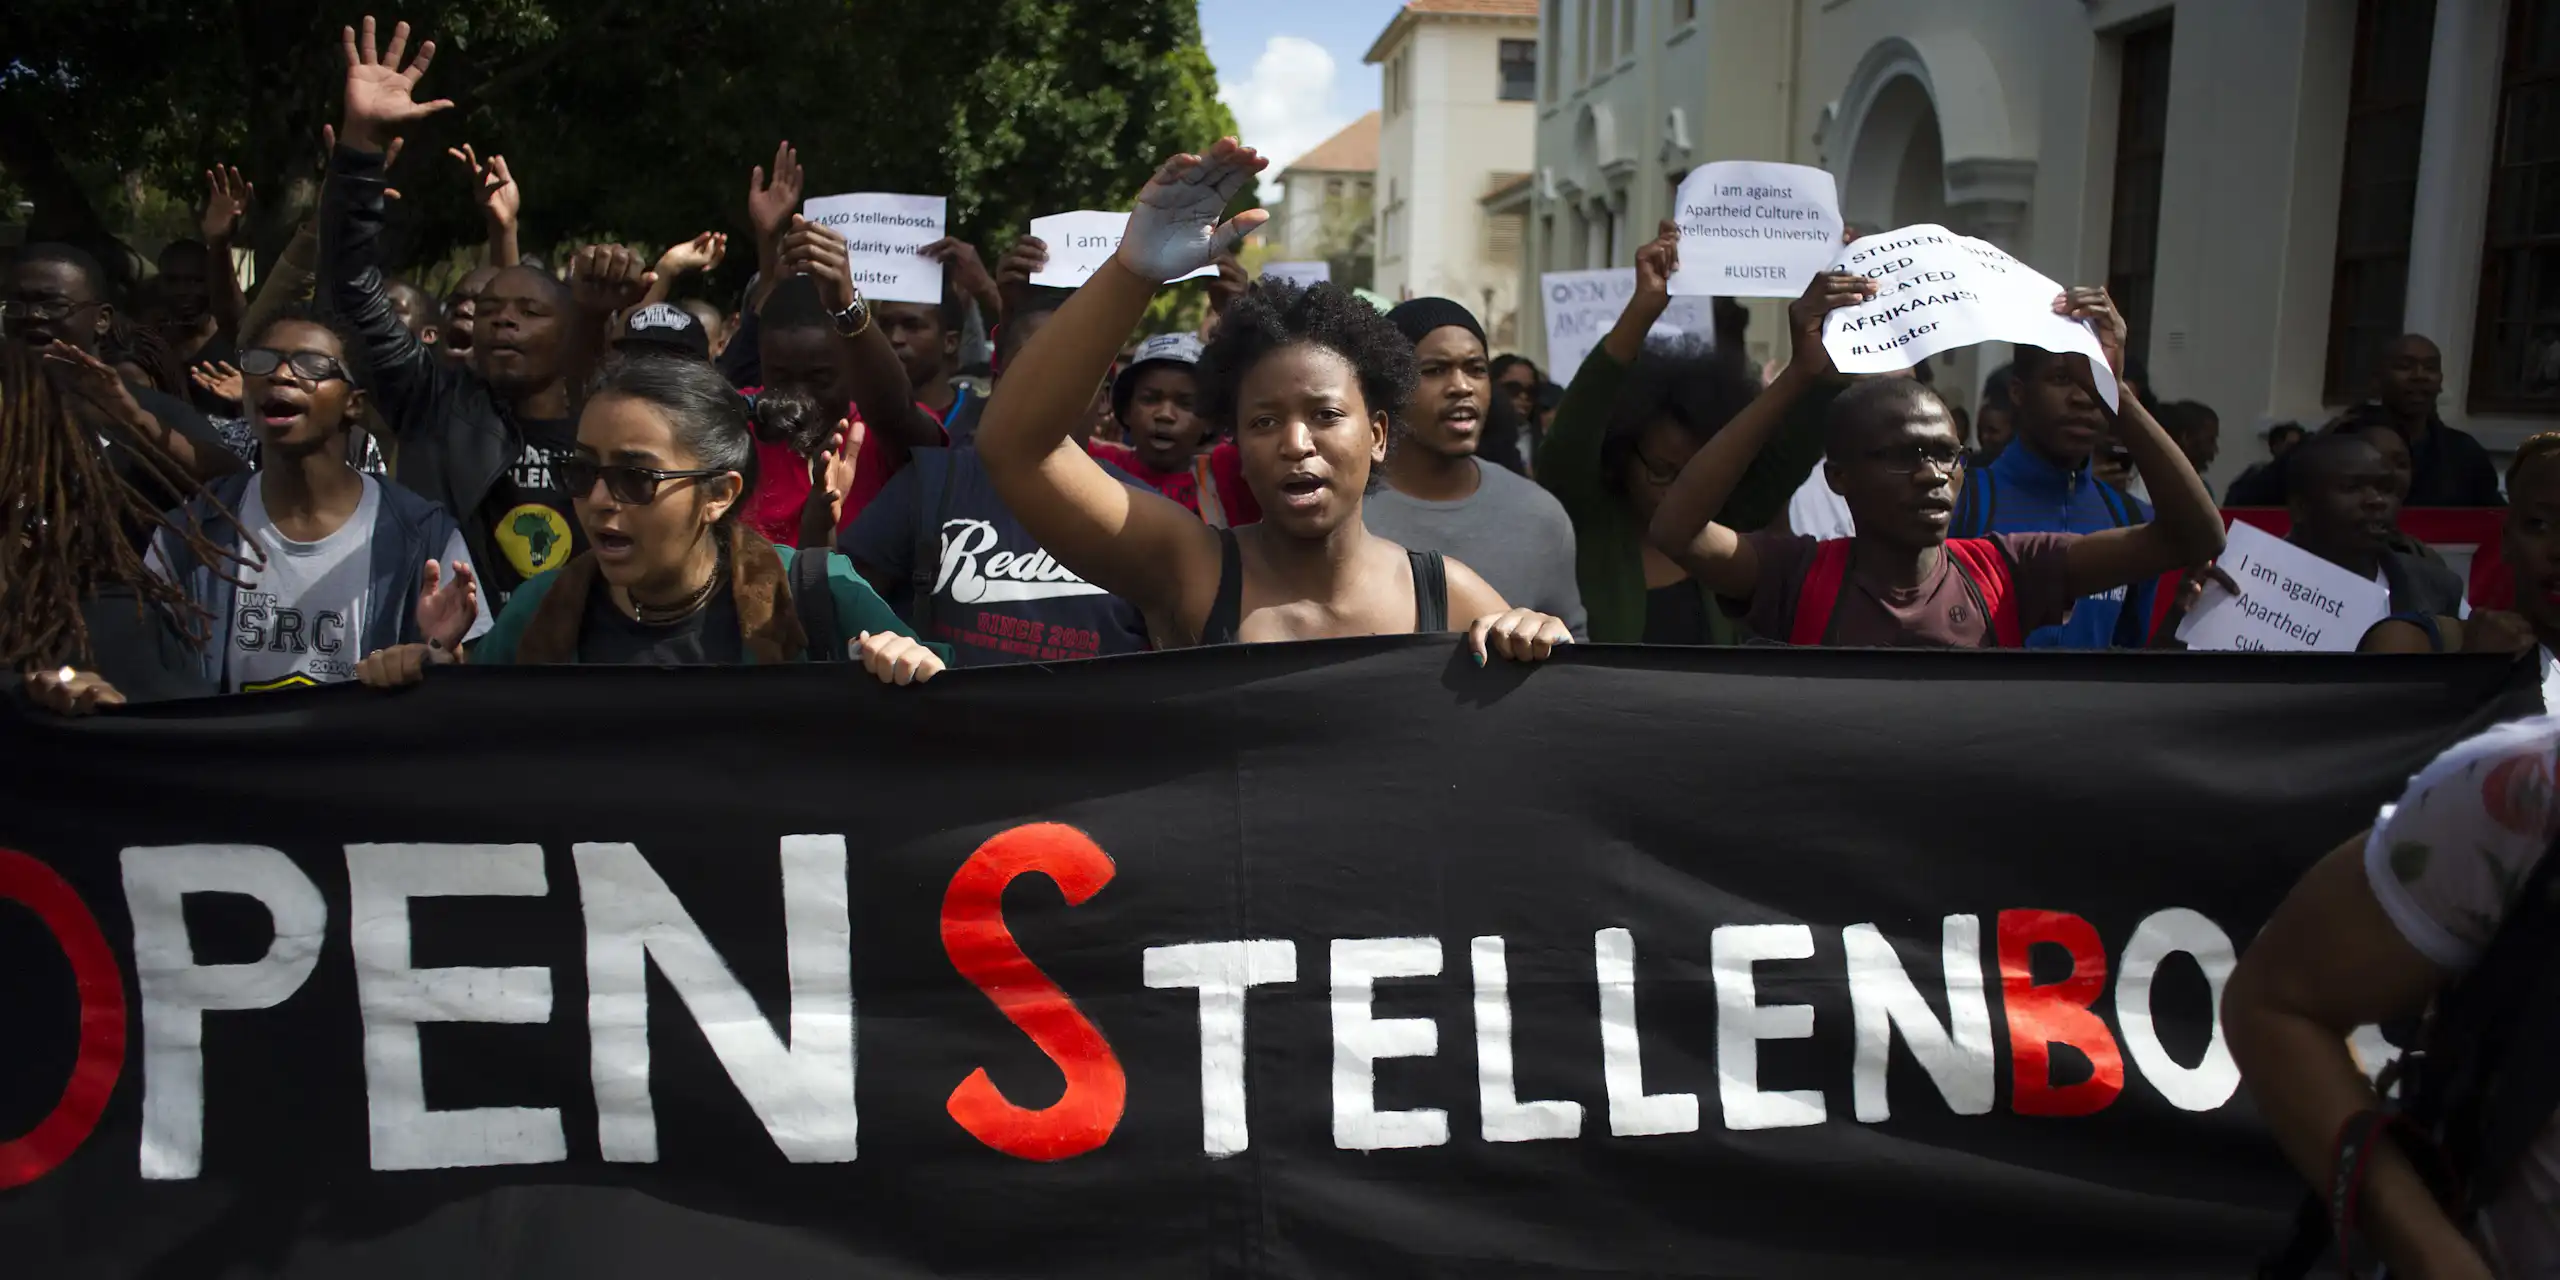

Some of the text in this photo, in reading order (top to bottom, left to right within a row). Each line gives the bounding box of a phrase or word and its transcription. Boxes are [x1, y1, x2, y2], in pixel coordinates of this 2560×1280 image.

[1721, 186, 1742, 197] am
[1746, 185, 1793, 200] against
[853, 212, 935, 229] Stellenbosch
[1685, 204, 1820, 221] Apartheid Culture in
[1065, 233, 1070, 248] I
[1077, 236, 1107, 248] am
[1763, 227, 1830, 243] University
[845, 240, 891, 256] lidarity
[853, 270, 898, 284] uister
[1724, 264, 1787, 280] #LUISTER
[1850, 320, 1940, 356] #Luister
[2239, 554, 2345, 618] I am against
[237, 591, 277, 608] UWC
[977, 612, 1045, 643] SINCE
[2235, 593, 2322, 646] Apartheid
[236, 606, 344, 656] SRC
[940, 822, 2241, 1161] STELLENBO
